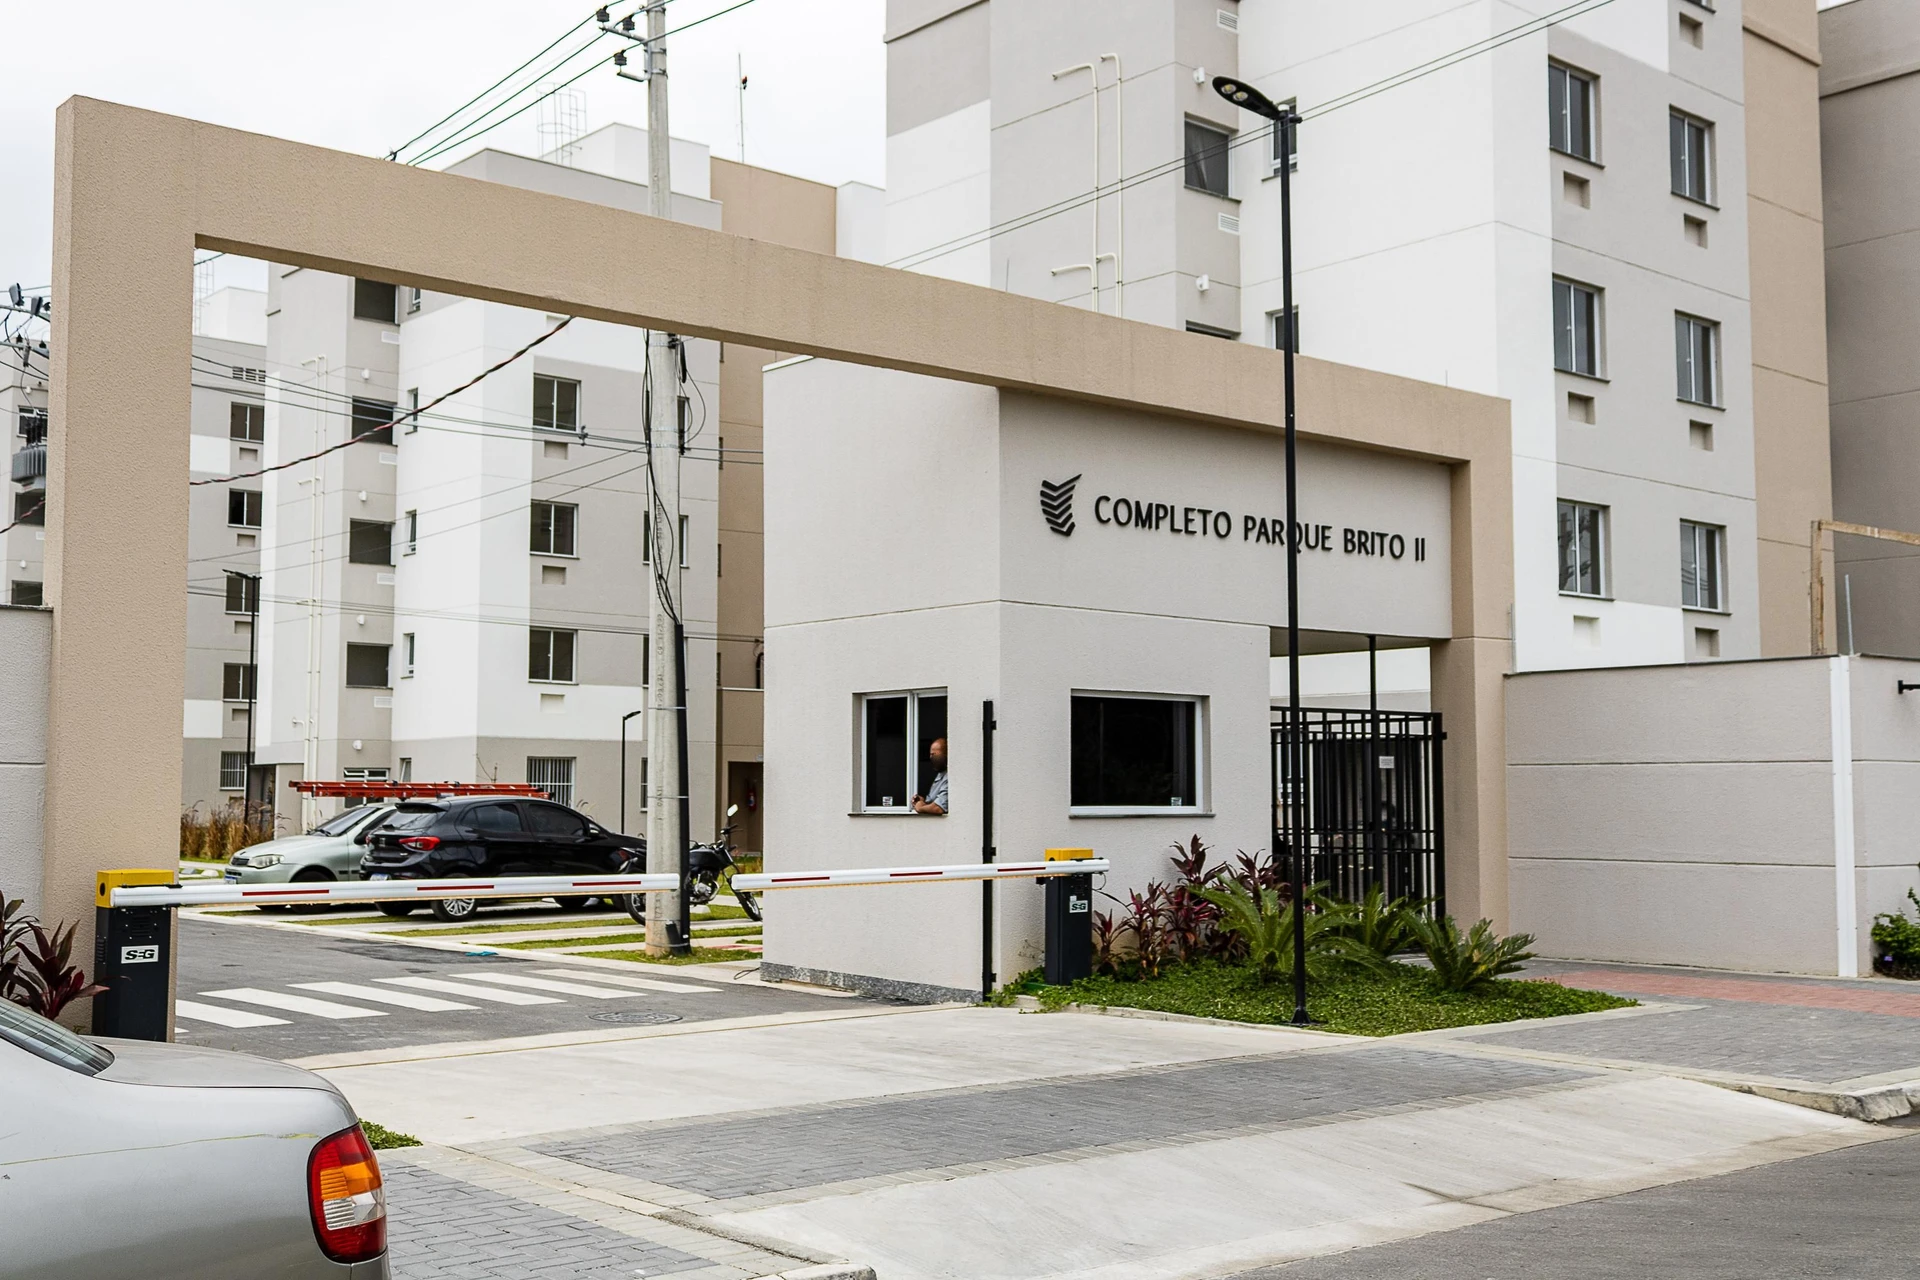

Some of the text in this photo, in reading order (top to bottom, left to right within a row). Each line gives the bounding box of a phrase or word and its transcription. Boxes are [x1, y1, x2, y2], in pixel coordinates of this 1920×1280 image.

[1094, 495, 1232, 539] COMPLETO
[1343, 527, 1405, 560] BRITO
[1414, 537, 1426, 562] II
